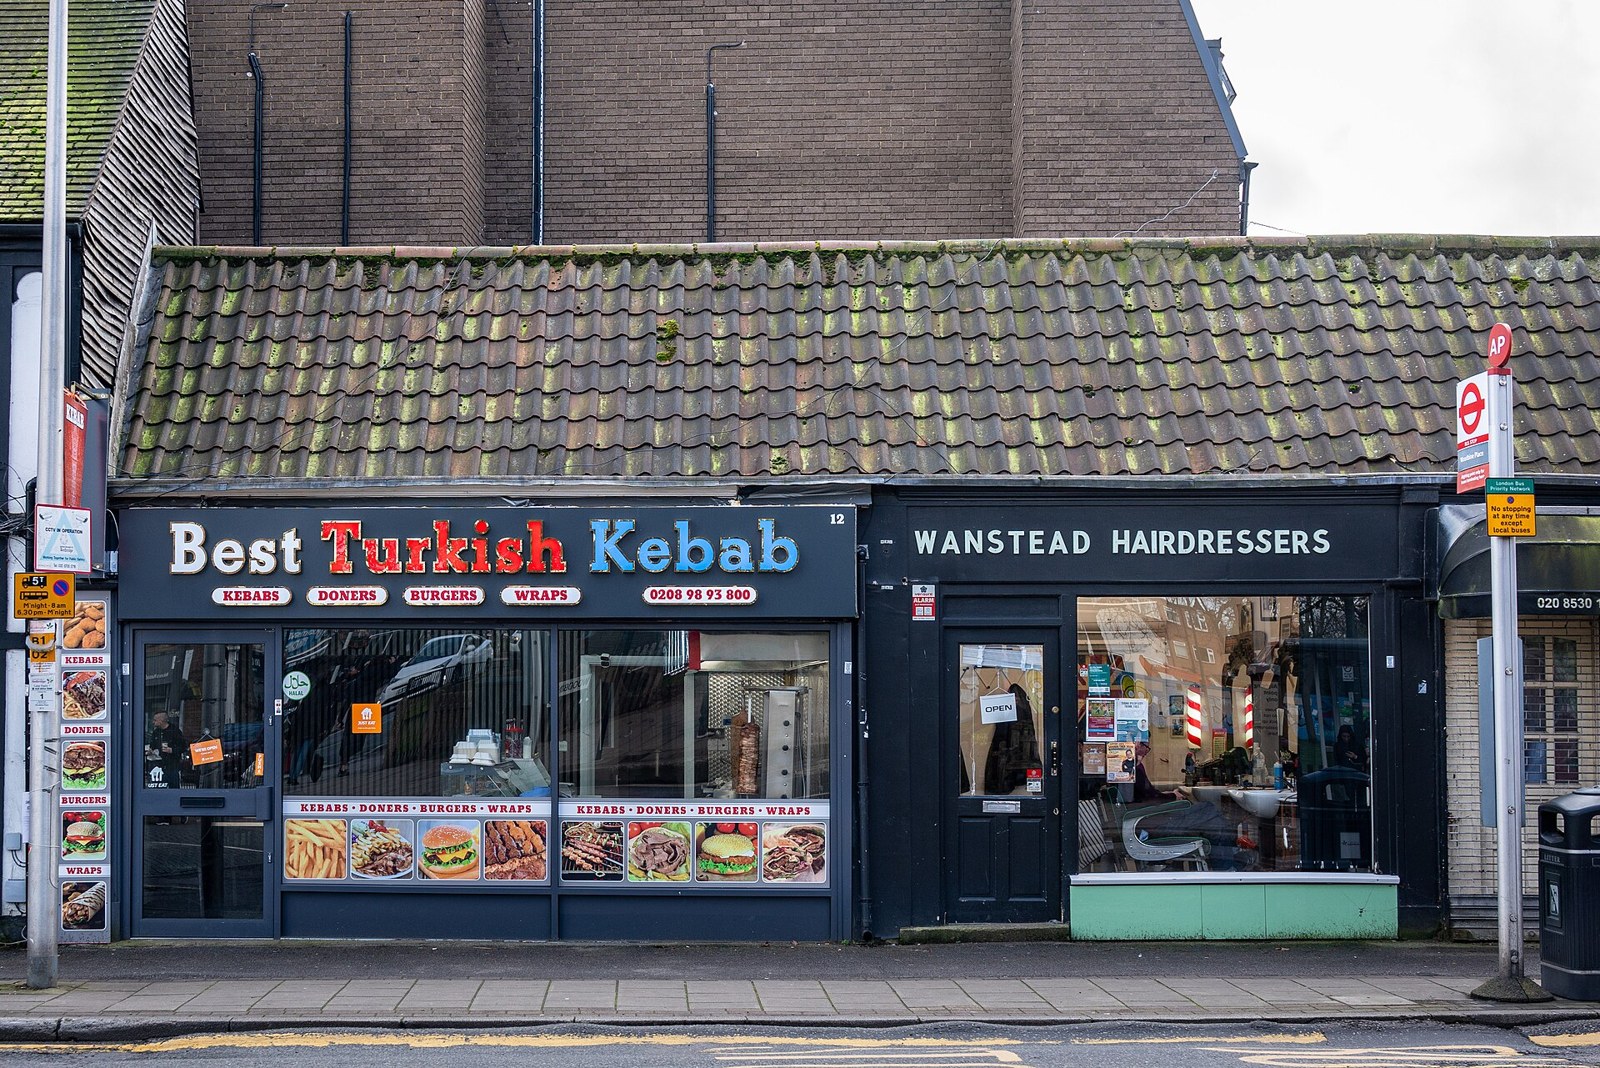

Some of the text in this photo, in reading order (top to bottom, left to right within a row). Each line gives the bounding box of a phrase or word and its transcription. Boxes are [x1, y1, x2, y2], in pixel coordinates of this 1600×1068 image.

[1489, 335, 1506, 357] AP
[830, 514, 845, 525] 12
[168, 518, 800, 575] Best Turkish Kebab
[914, 529, 1331, 555] WANSTEAD HAIRDRESSERS
[32, 576, 44, 585] 5T
[222, 590, 280, 602] KEBABS
[317, 590, 377, 601] DONERS
[410, 590, 478, 601] BURGERS
[514, 590, 568, 601] WRAPS
[650, 589, 750, 600] 0208 98 93 800
[1537, 597, 1560, 608] 020
[1563, 598, 1592, 609] 8530
[65, 656, 104, 664] KEBABS
[284, 675, 308, 689] حلال
[985, 705, 1013, 713] OPEN
[64, 726, 104, 734] DONERS
[61, 796, 107, 804] BURGERS
[300, 804, 532, 813] KEBABS DONERS BURGERS WRAPS
[576, 806, 811, 815] KEBABS DONERS BURGERS WRAPS
[66, 866, 102, 875] WRAPS
